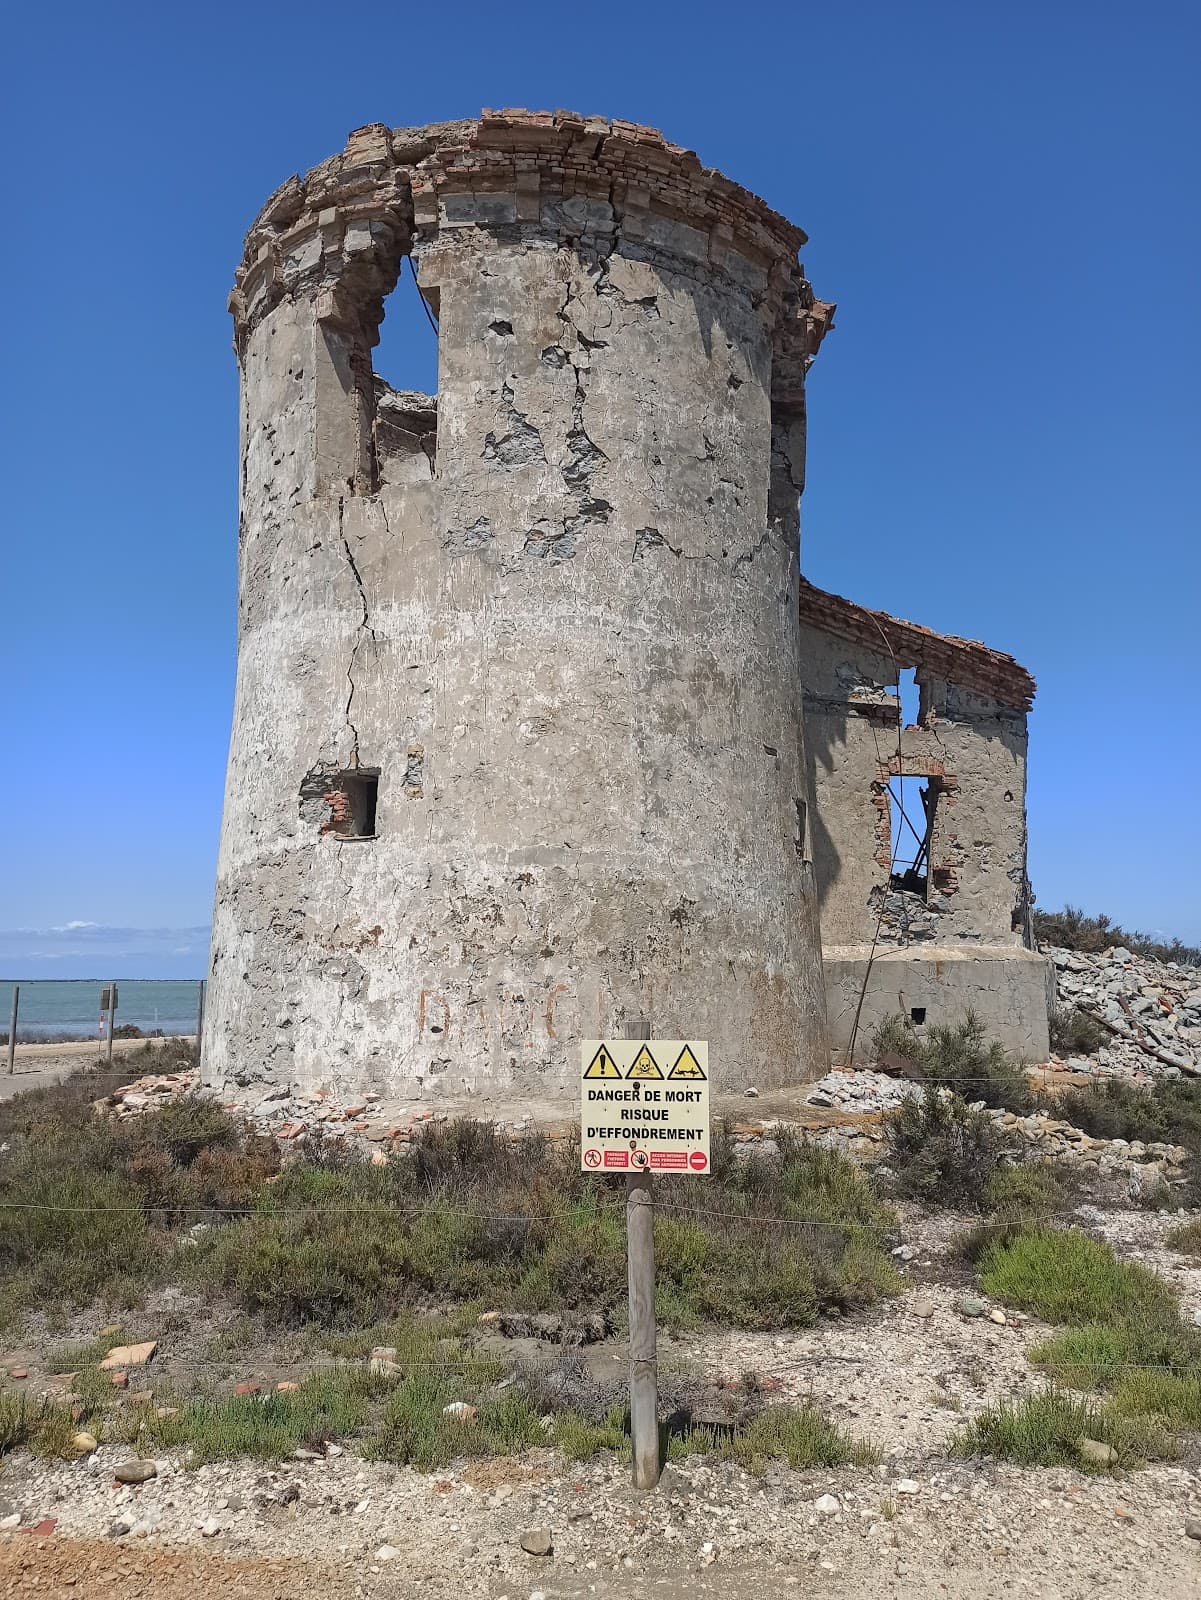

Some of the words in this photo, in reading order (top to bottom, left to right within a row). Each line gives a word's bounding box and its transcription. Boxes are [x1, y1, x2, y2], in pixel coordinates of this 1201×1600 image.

[588, 1089, 640, 1101] DANGER
[644, 1090, 661, 1102] DE
[665, 1091, 702, 1102] MORT
[621, 1109, 669, 1121] RISQUE
[587, 1127, 704, 1140] D'EFFONDREMENT
